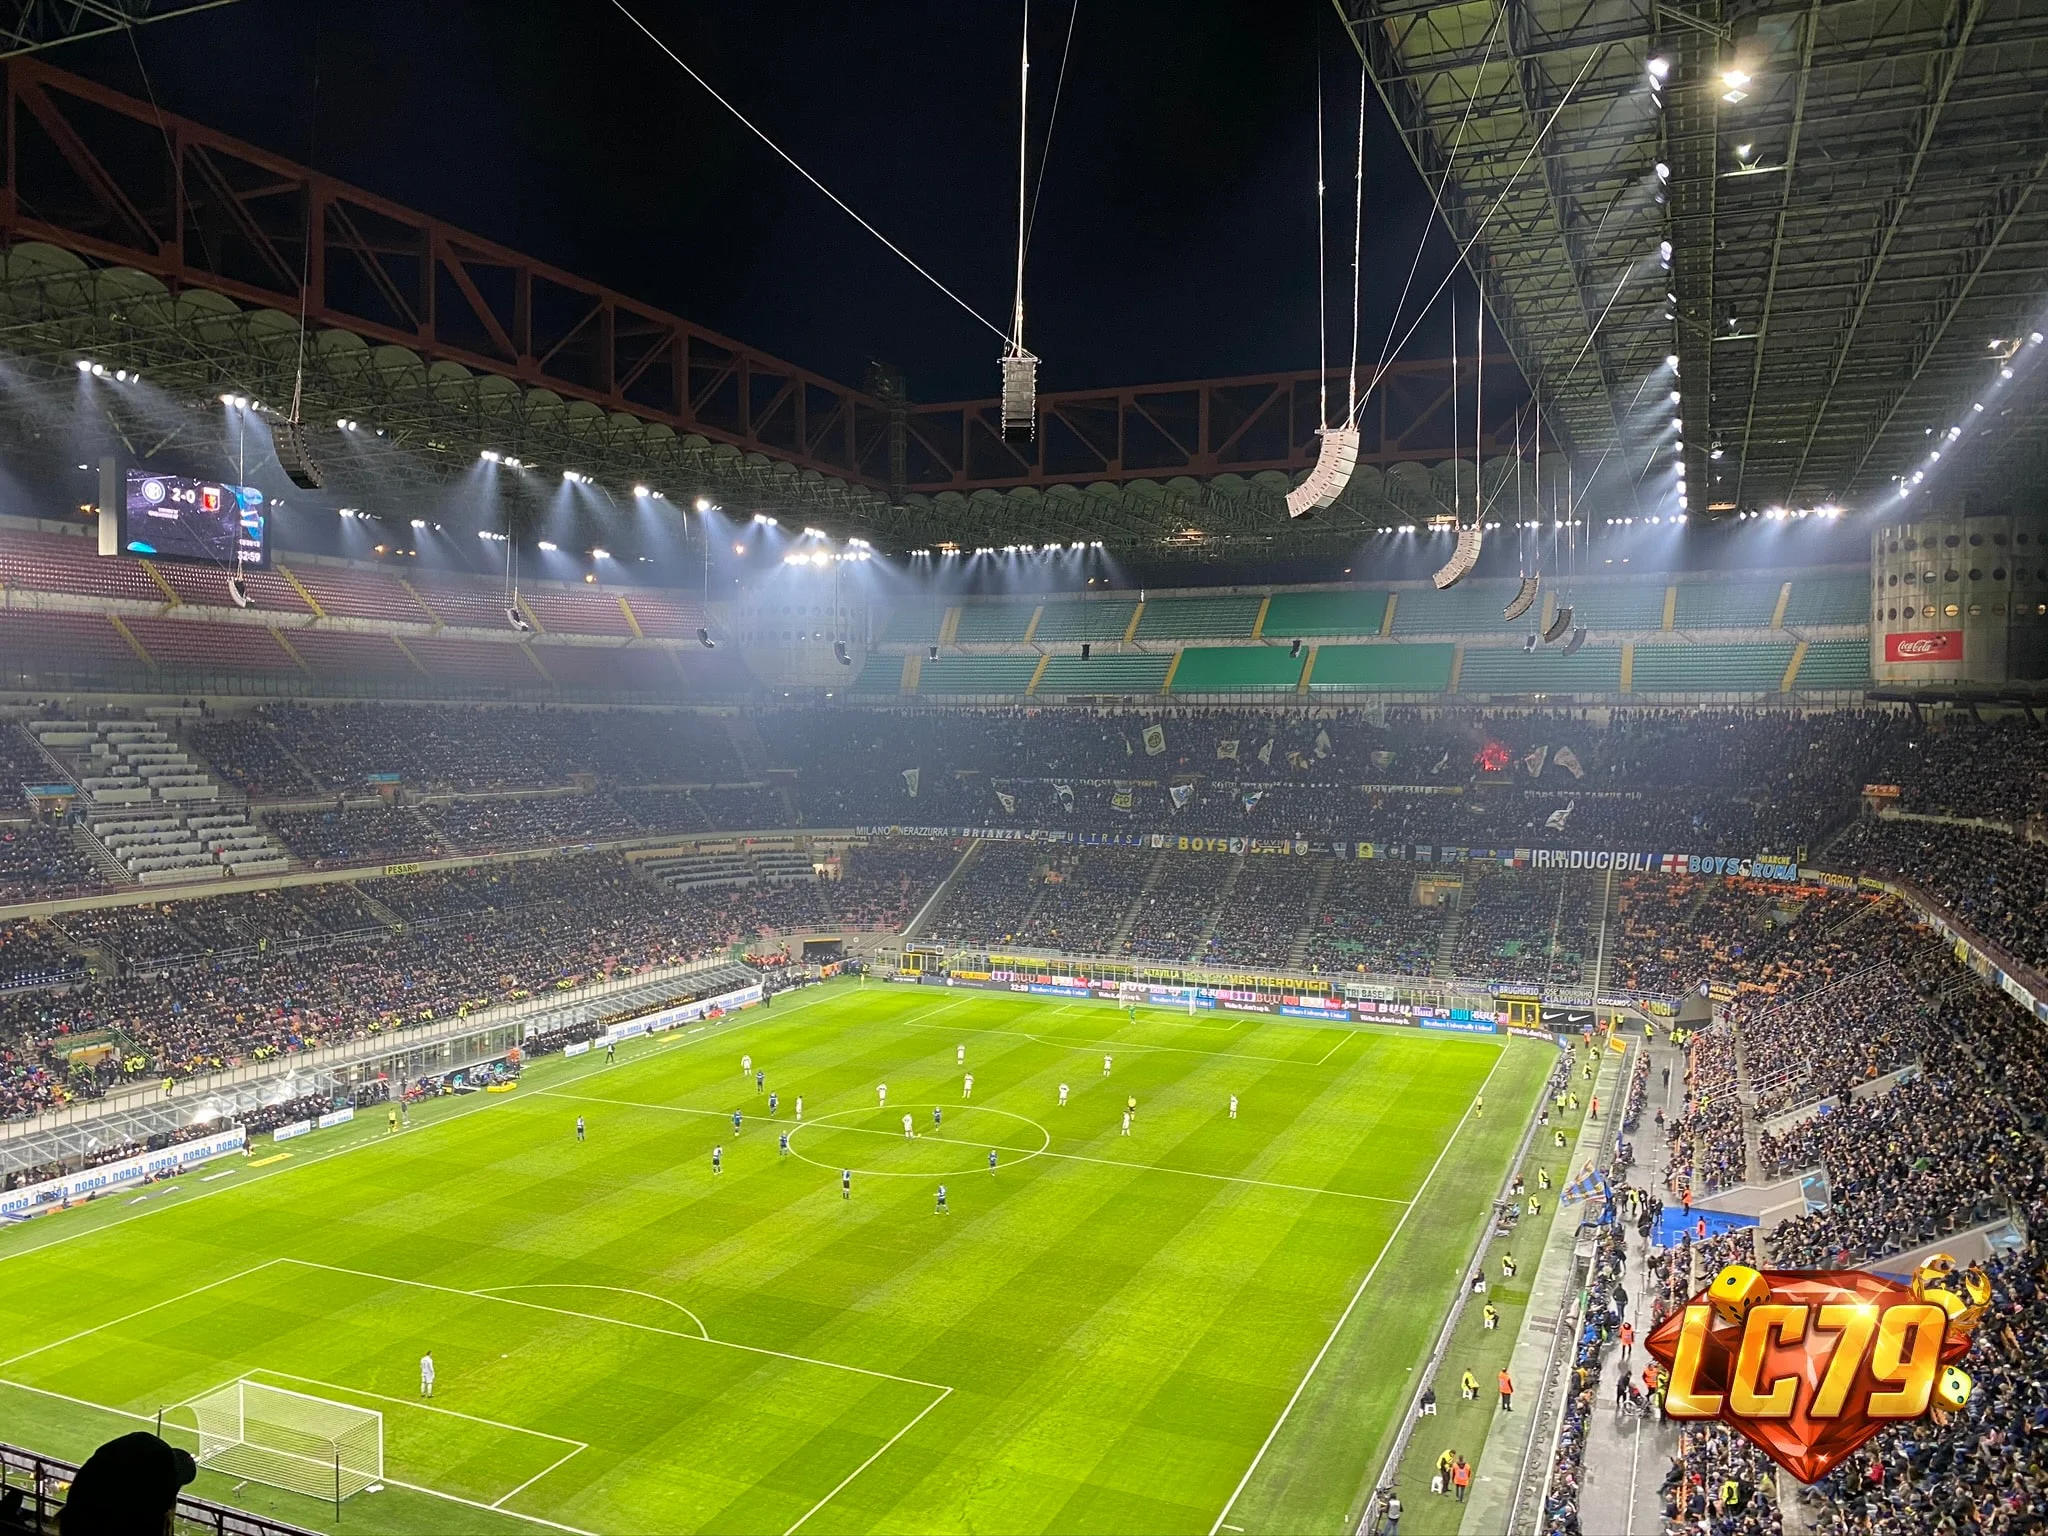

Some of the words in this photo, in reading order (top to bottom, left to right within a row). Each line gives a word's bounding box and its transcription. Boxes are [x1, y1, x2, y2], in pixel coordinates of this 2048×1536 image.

[172, 487, 195, 504] 2-0
[856, 826, 890, 836] MILANO
[898, 826, 948, 837] NERAZZURRA
[963, 828, 1022, 840] BRIANZA
[1067, 832, 1132, 844] ULTRAS
[1178, 837, 1228, 852] BOYS
[1688, 856, 1740, 876] BOYS
[1752, 860, 1797, 882] ROMA
[1820, 872, 1853, 888] TORRITA
[1144, 968, 1180, 978] ALTAVILLA
[1500, 986, 1539, 996] BRUGHERIO
[1544, 996, 1590, 1006] CIAMPINO
